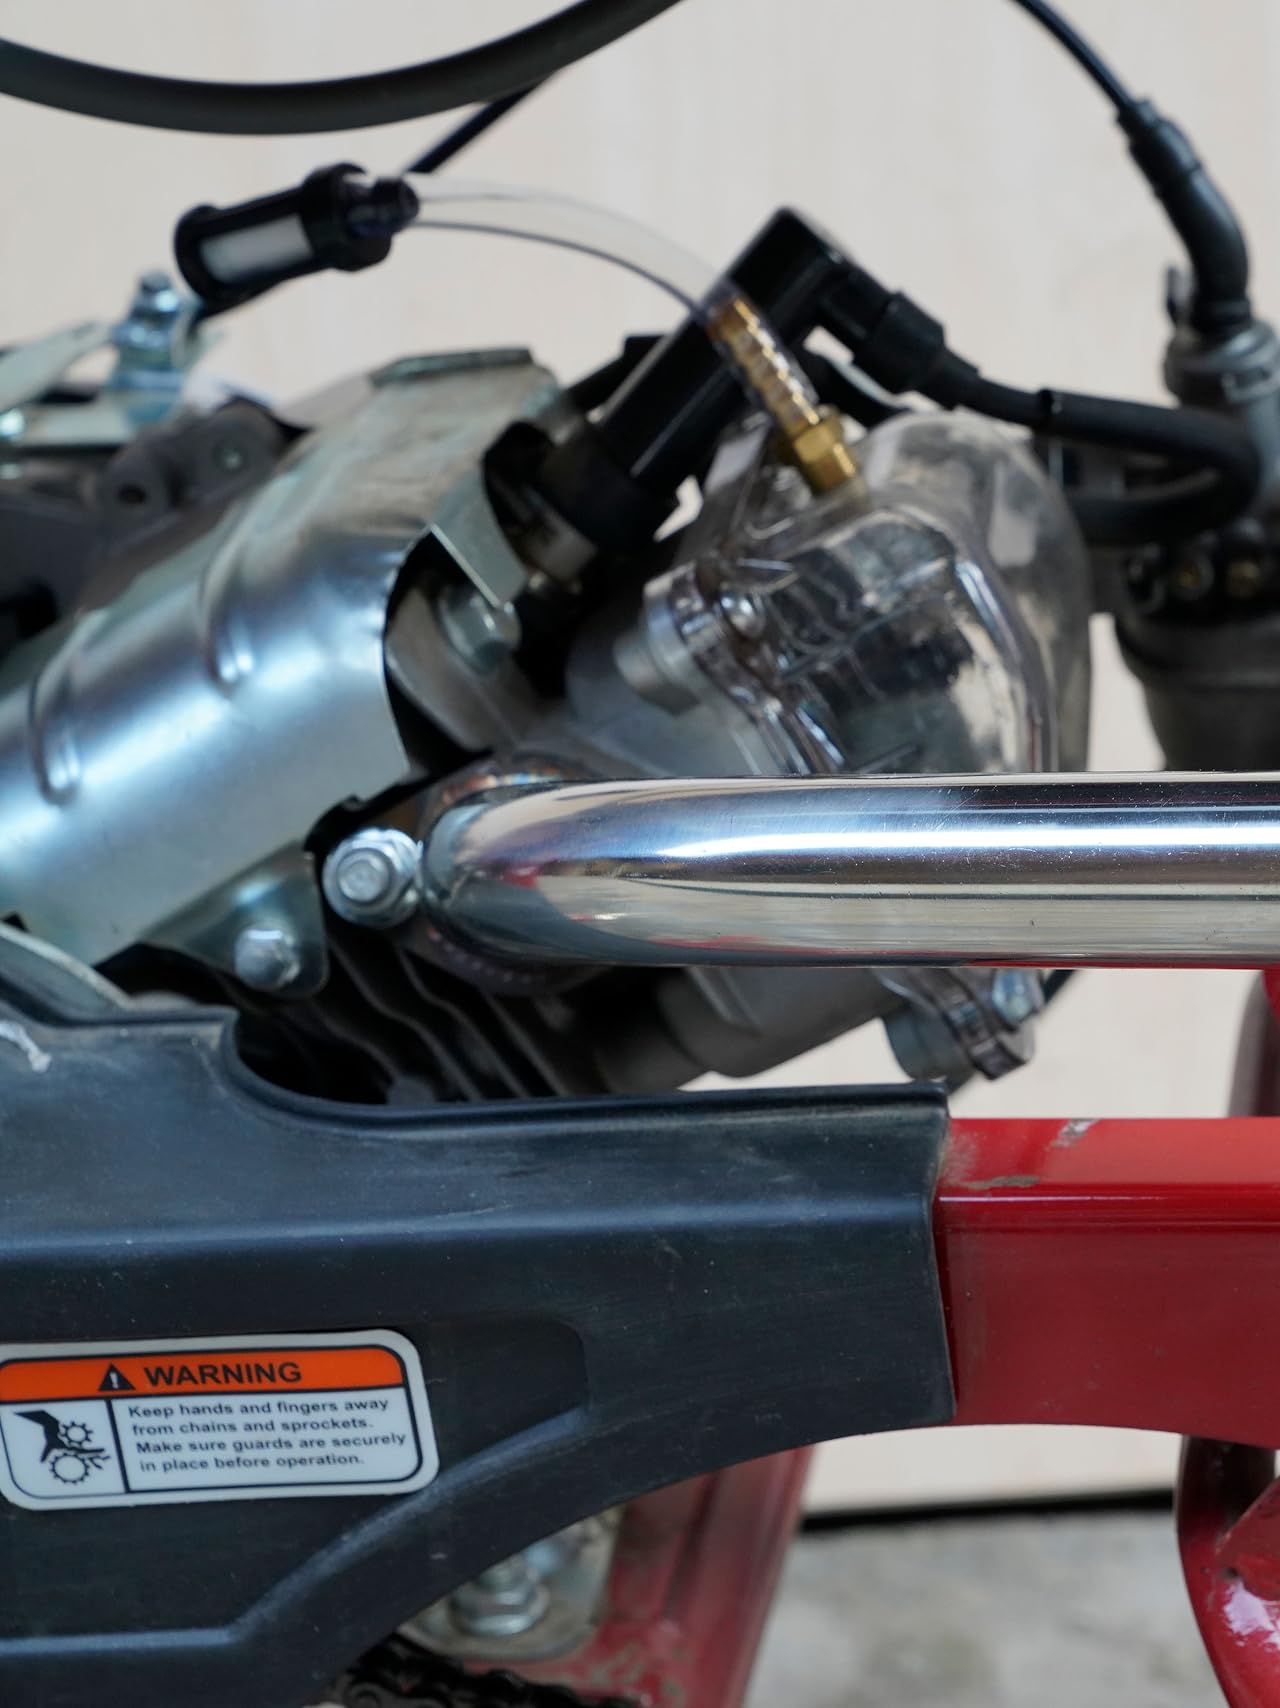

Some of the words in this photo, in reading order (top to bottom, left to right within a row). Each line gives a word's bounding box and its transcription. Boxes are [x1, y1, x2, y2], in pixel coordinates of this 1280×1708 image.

[143, 1361, 302, 1387] WARNING
[128, 1406, 174, 1419] Keep
[179, 1403, 234, 1415] hands
[240, 1402, 272, 1414] and
[277, 1401, 339, 1416] fingers
[344, 1400, 389, 1412] away
[132, 1424, 174, 1436] from
[179, 1421, 237, 1434] chains
[243, 1420, 275, 1432] and
[280, 1418, 373, 1433] sprockets.
[136, 1441, 183, 1454] Make
[188, 1441, 227, 1452] sure
[232, 1437, 293, 1453] guards
[299, 1439, 326, 1448] are
[331, 1432, 406, 1447] securely
[140, 1461, 156, 1472] in
[162, 1459, 209, 1473] place
[214, 1456, 270, 1469] before
[276, 1454, 363, 1469] operation.
